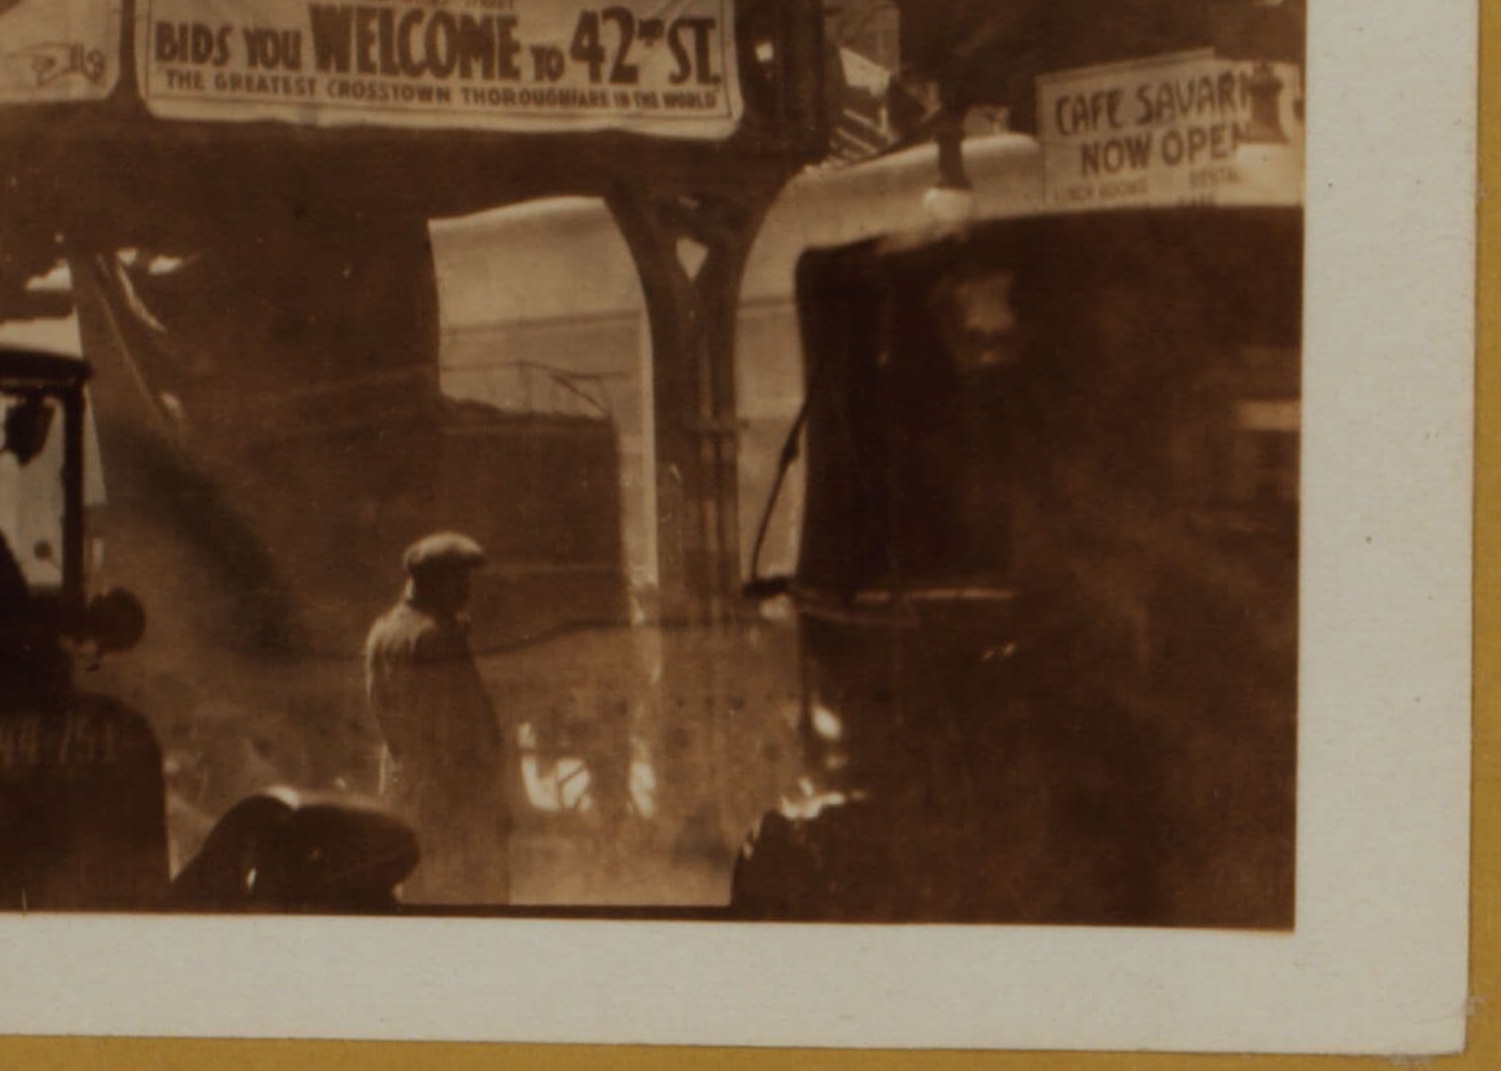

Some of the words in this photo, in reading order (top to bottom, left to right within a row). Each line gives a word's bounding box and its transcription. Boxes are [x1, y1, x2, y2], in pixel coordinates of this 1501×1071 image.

[154, 20, 232, 68] BIDS
[243, 28, 304, 71] YOU
[307, 2, 522, 82] WELCOME
[529, 44, 566, 83] TO
[167, 70, 206, 91] THE
[213, 72, 318, 97] GREATEST
[326, 78, 450, 103] CROSSTOWN
[612, 89, 631, 108] IN
[1055, 88, 1125, 136] CAFE
[1080, 133, 1151, 179] NOW
